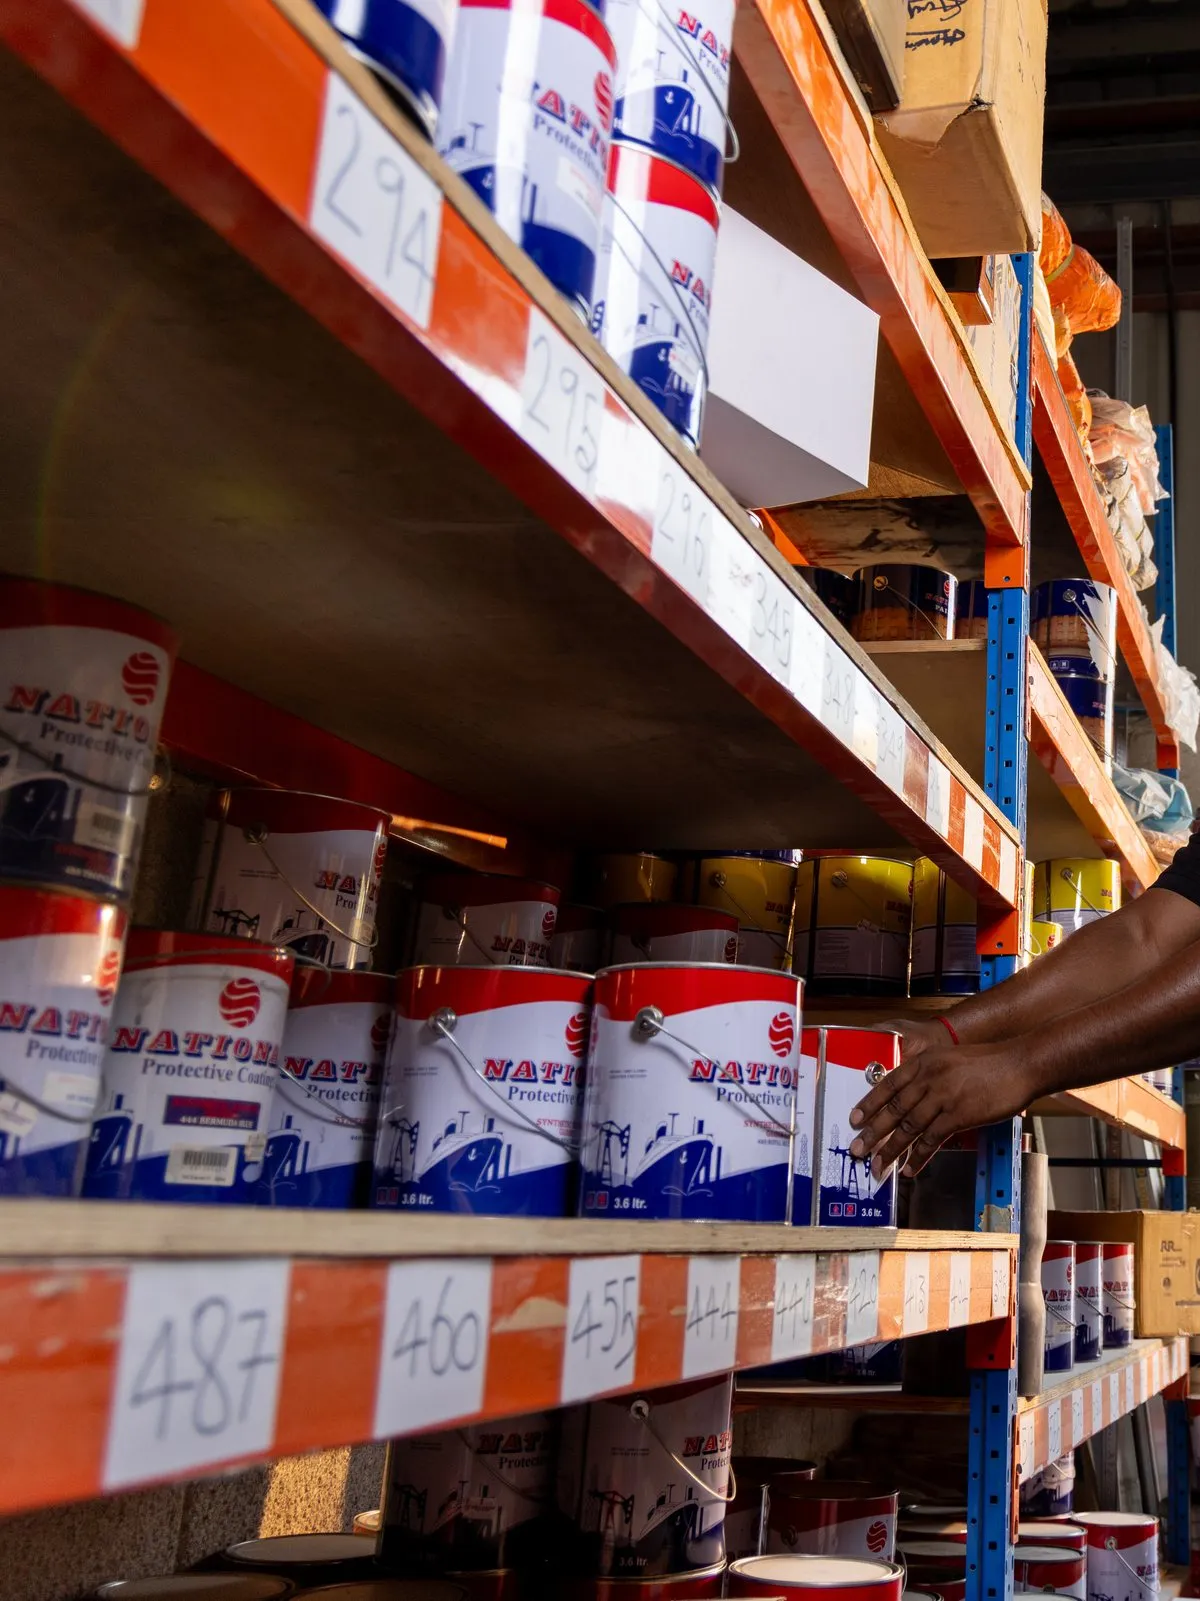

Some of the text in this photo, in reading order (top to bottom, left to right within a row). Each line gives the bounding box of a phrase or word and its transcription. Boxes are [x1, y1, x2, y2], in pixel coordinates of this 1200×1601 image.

[323, 103, 436, 313] 294
[141, 1058, 234, 1083] Protective
[716, 1086, 782, 1107] Protective
[401, 1192, 417, 1205] 3.6
[614, 1197, 648, 1209] 3.6 ltr.
[861, 1208, 883, 1217] 3.6 ltr.
[392, 1277, 480, 1378] 460
[129, 1295, 279, 1440] 487
